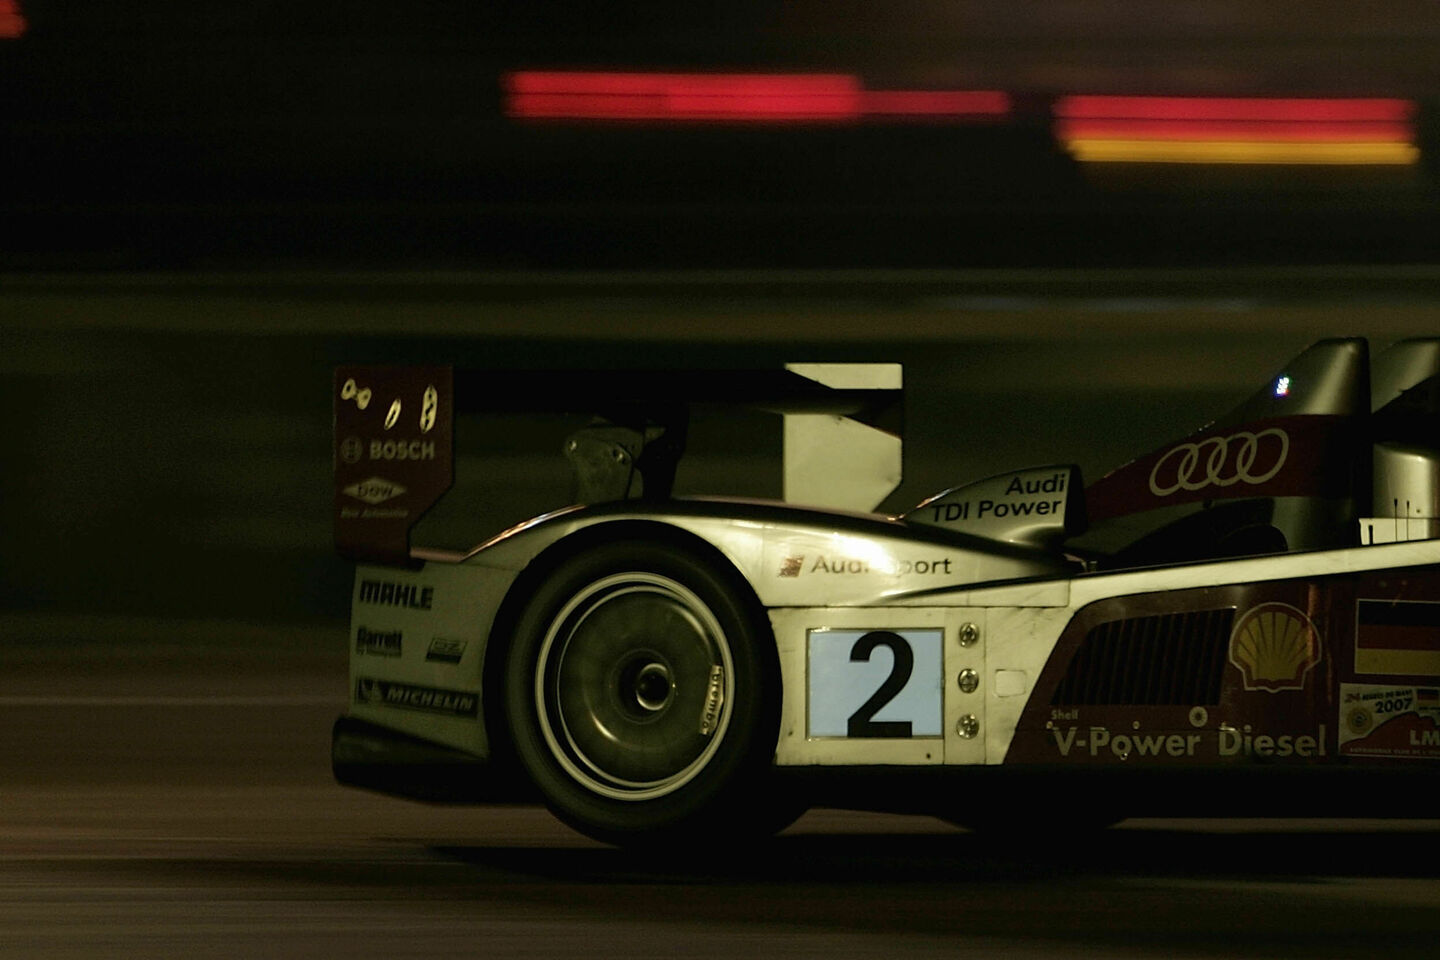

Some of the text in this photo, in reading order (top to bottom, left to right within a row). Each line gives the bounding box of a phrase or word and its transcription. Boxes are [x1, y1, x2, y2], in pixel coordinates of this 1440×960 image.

[369, 439, 436, 461] BOSCH
[1006, 474, 1066, 496] Audi
[932, 499, 1062, 522] TDI Power
[360, 581, 433, 610] MAHLE
[847, 631, 914, 738] 2
[387, 686, 475, 712] MICHELIN
[702, 667, 722, 729] brembo
[1375, 697, 1413, 714] 2007
[1051, 709, 1079, 720] Shell
[1053, 724, 1327, 757] V-Power Diesel
